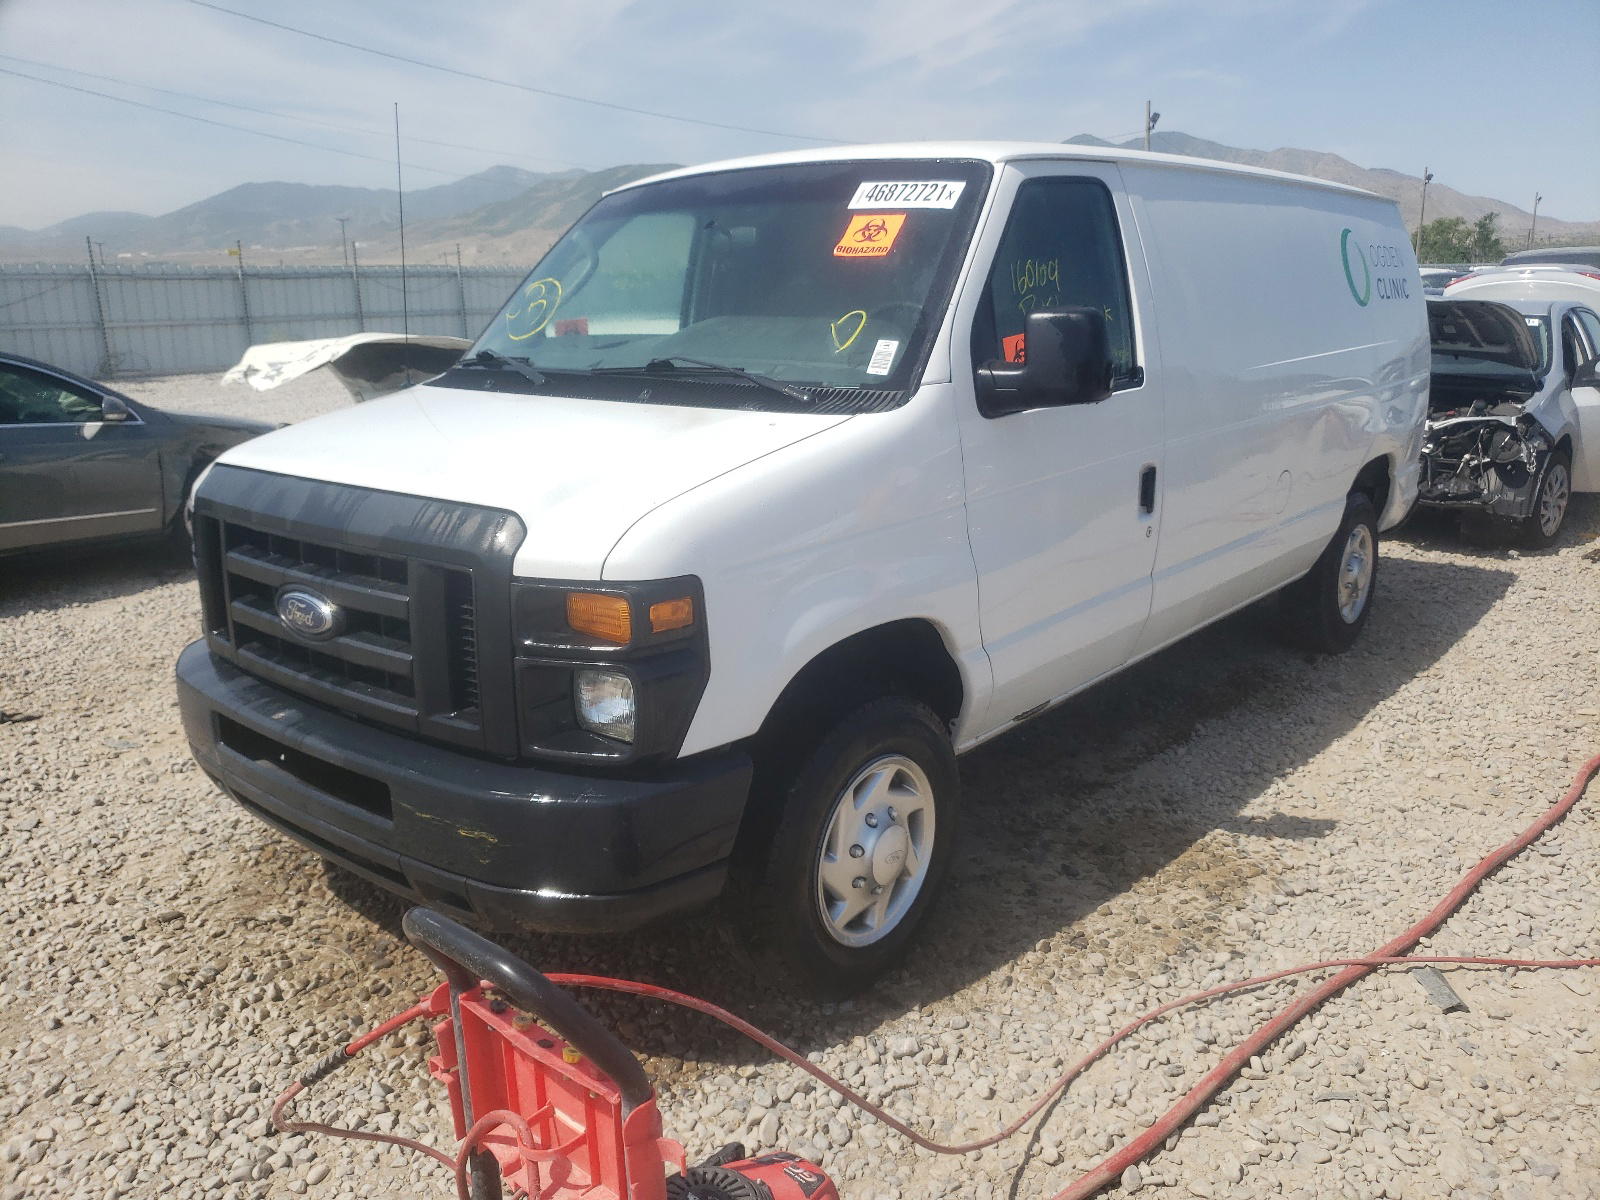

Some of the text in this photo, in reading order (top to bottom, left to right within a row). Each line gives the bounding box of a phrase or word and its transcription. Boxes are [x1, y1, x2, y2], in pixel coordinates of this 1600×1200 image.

[836, 245, 889, 255] BIOHAZARD
[1376, 278, 1409, 299] CLINIC
[286, 599, 314, 627] Ford
